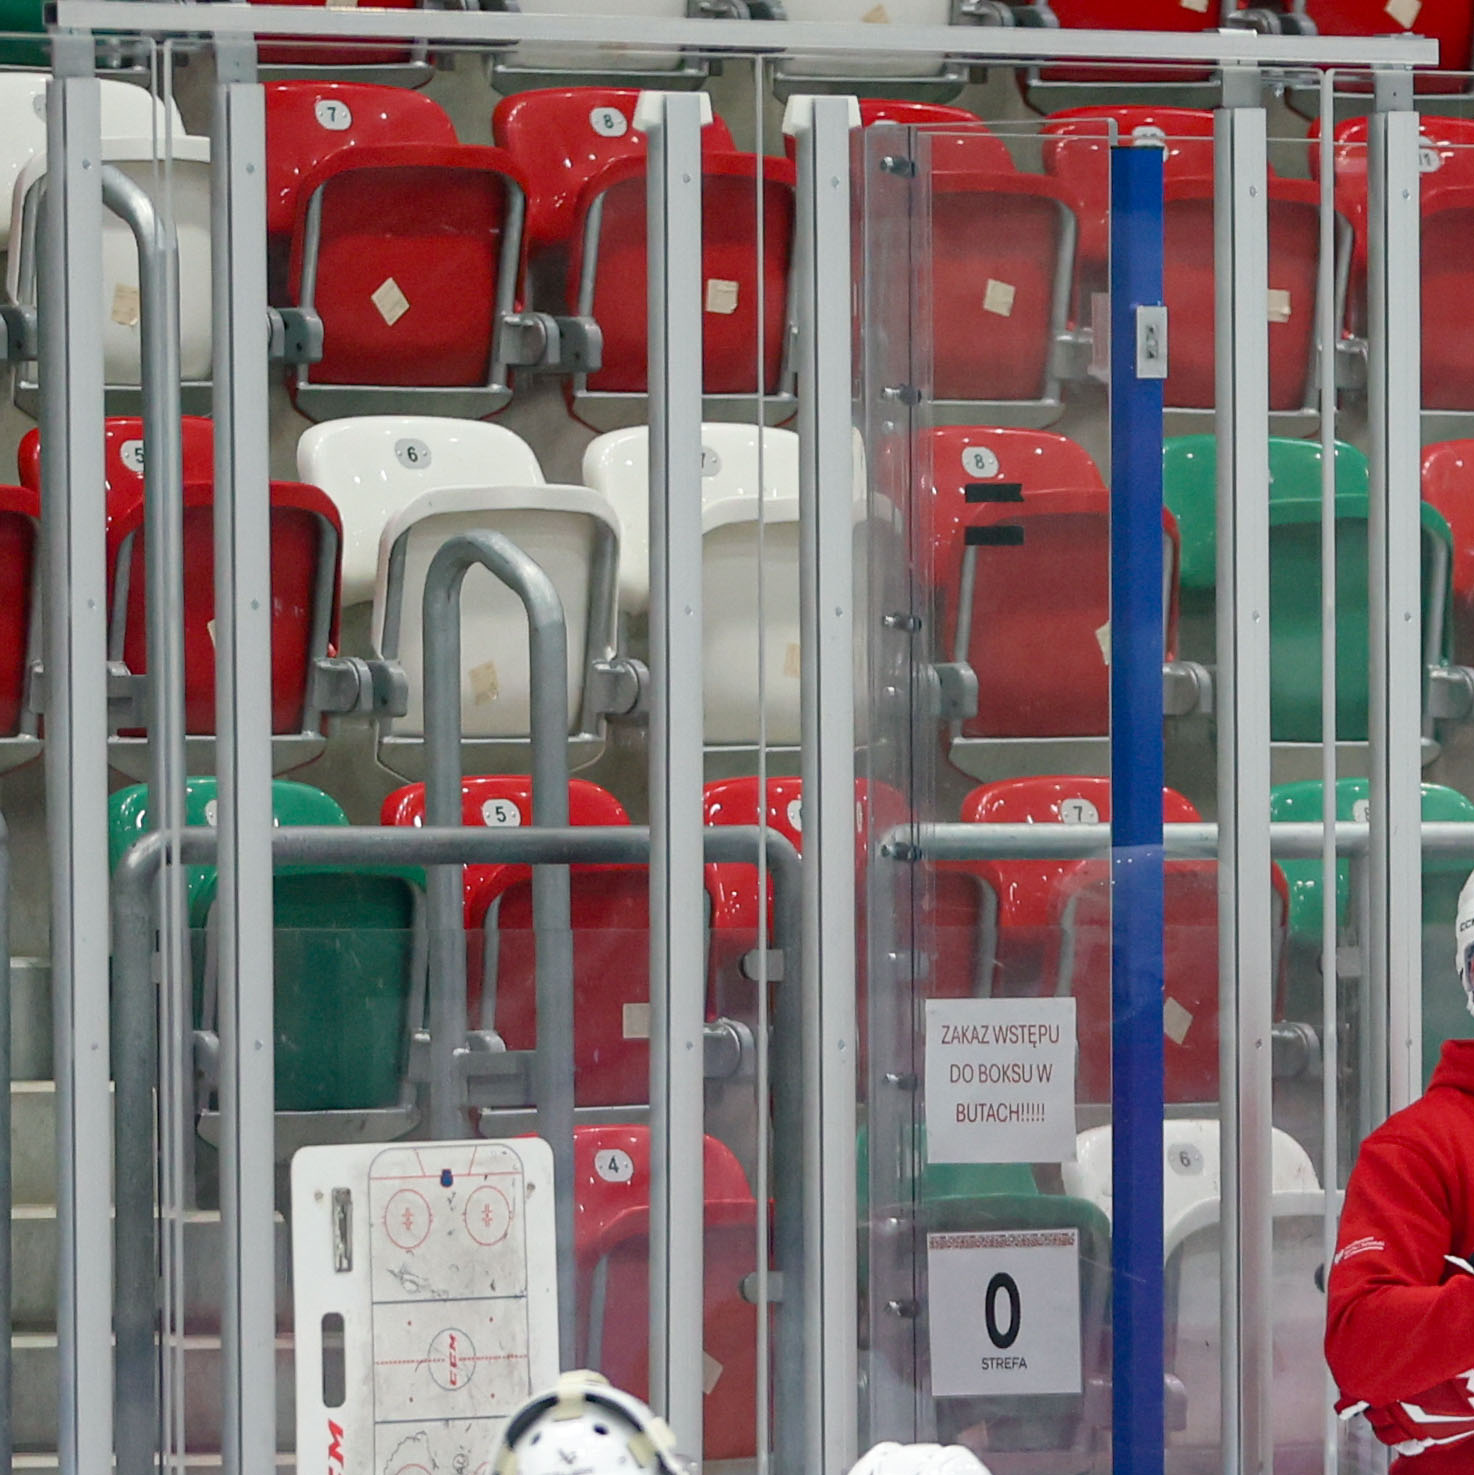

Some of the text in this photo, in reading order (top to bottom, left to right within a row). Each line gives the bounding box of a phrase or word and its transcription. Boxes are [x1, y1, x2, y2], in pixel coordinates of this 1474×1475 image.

[327, 107, 336, 122] 7
[603, 114, 613, 129] 8
[135, 448, 144, 464] 5
[407, 446, 418, 463] 6
[974, 454, 985, 470] 8
[495, 807, 506, 823] 5
[1072, 806, 1083, 822] 7
[941, 1024, 1060, 1048] ZAKAZ WSTĘPU
[950, 1063, 1053, 1083] DO BOKSU W
[956, 1103, 1045, 1122] BUTACH!!!!!
[607, 1156, 618, 1174] 4
[1180, 1150, 1190, 1168] 6
[985, 1272, 1021, 1349] 0
[448, 1333, 458, 1386] CCM
[981, 1357, 1028, 1371] STREFA
